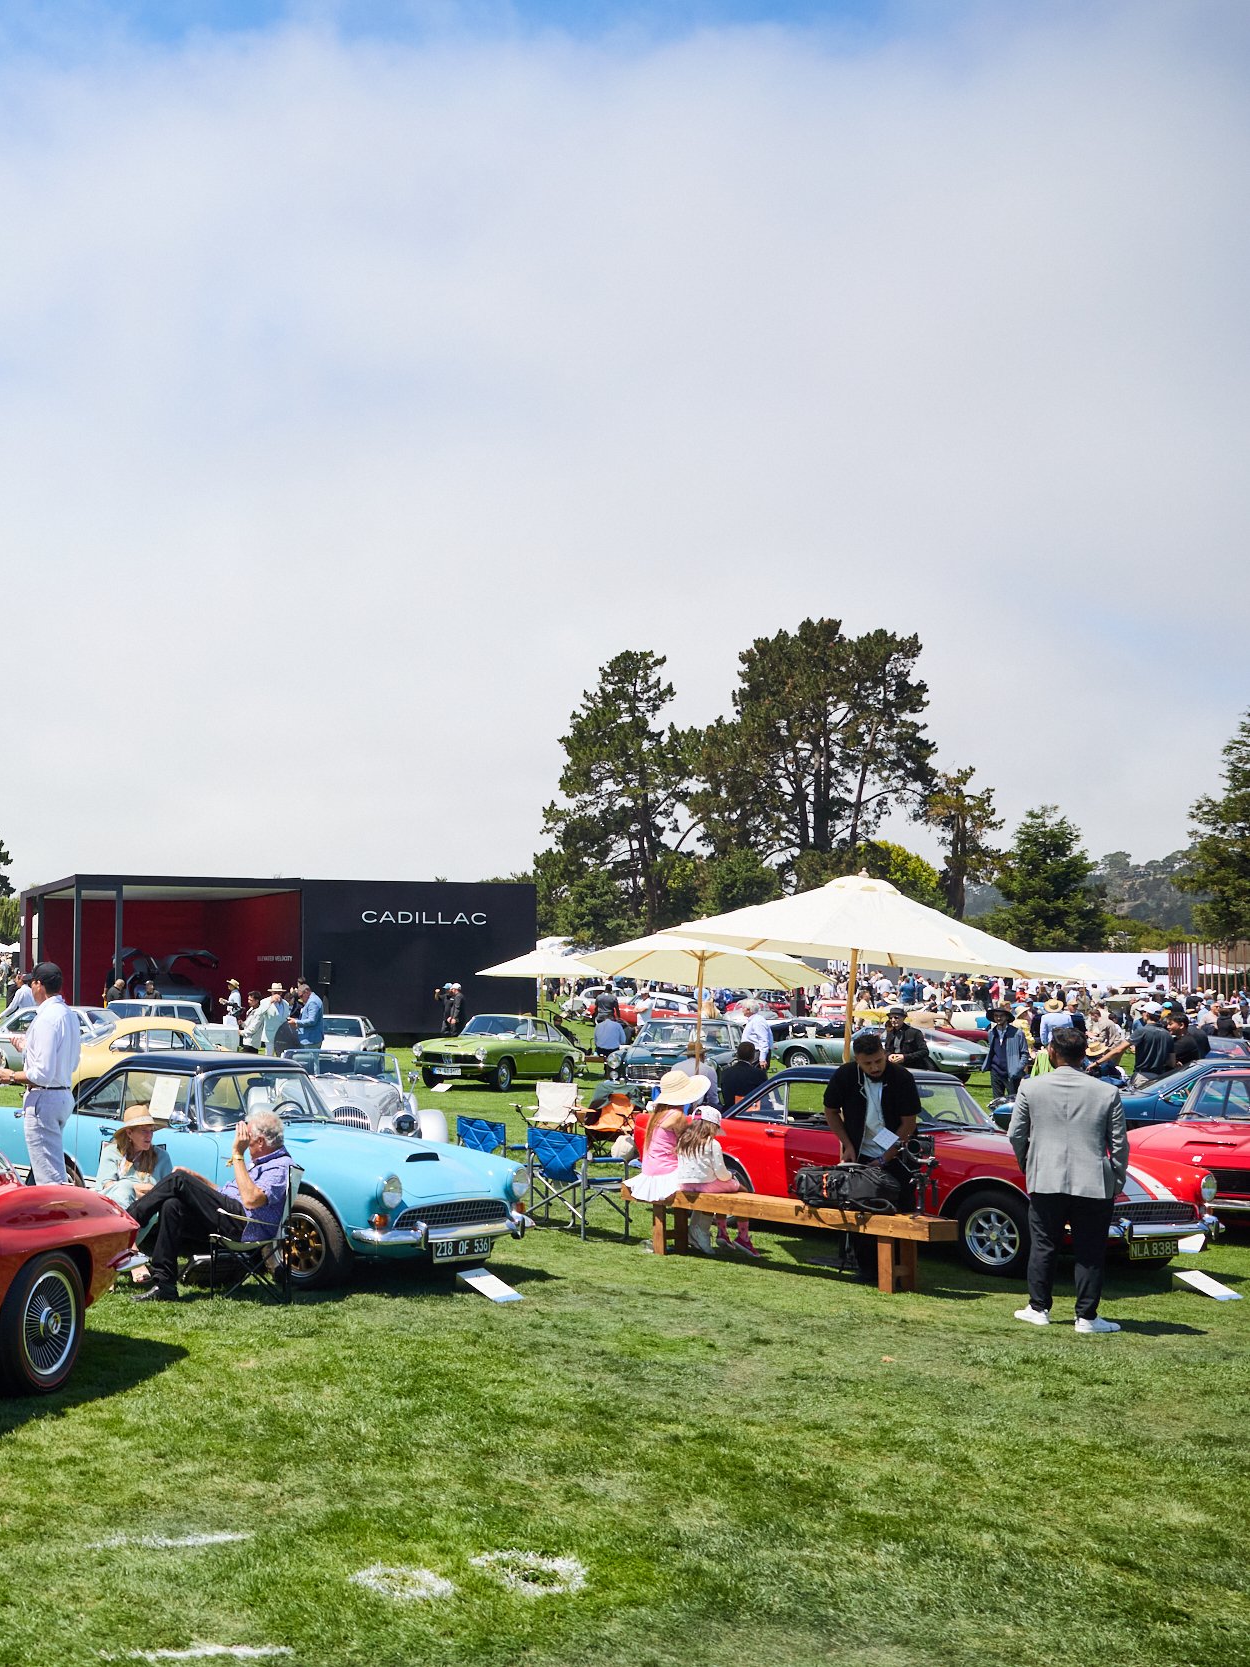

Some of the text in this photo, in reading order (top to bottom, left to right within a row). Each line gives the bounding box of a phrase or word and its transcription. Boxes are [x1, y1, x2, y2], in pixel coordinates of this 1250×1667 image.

[361, 910, 487, 925] CADILLAC
[436, 1238, 488, 1257] 218 OF 536
[1131, 1240, 1179, 1257] NLA 838E
